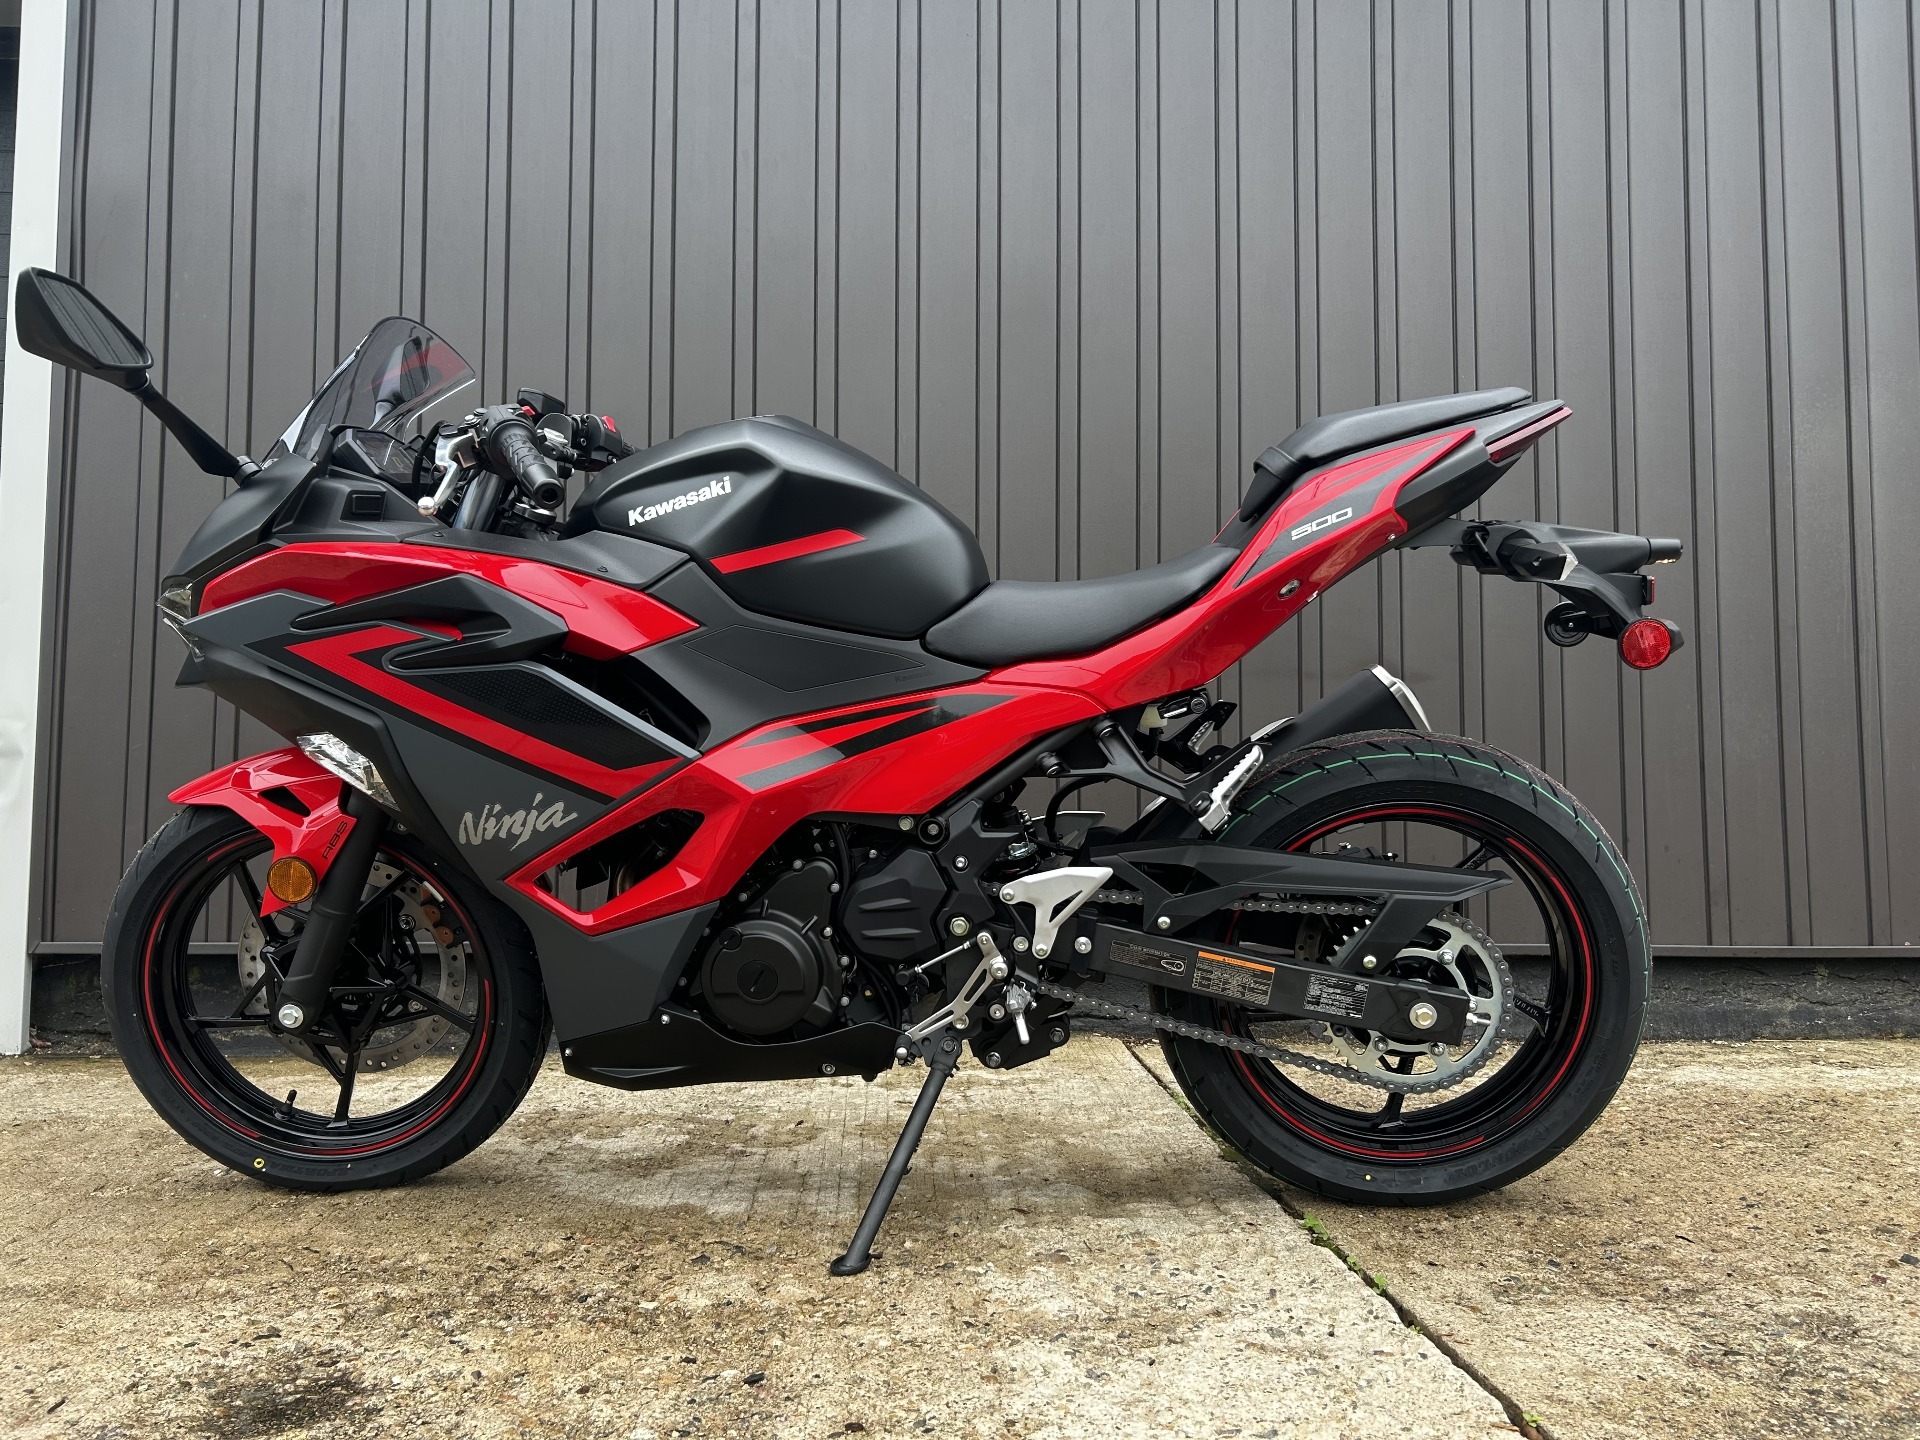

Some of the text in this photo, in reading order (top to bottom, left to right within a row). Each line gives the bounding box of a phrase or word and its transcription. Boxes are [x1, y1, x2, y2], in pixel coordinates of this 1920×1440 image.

[628, 476, 732, 527] Kawasaki
[1291, 507, 1353, 541] 500
[321, 820, 348, 860] ABS
[458, 792, 579, 851] Ninja
